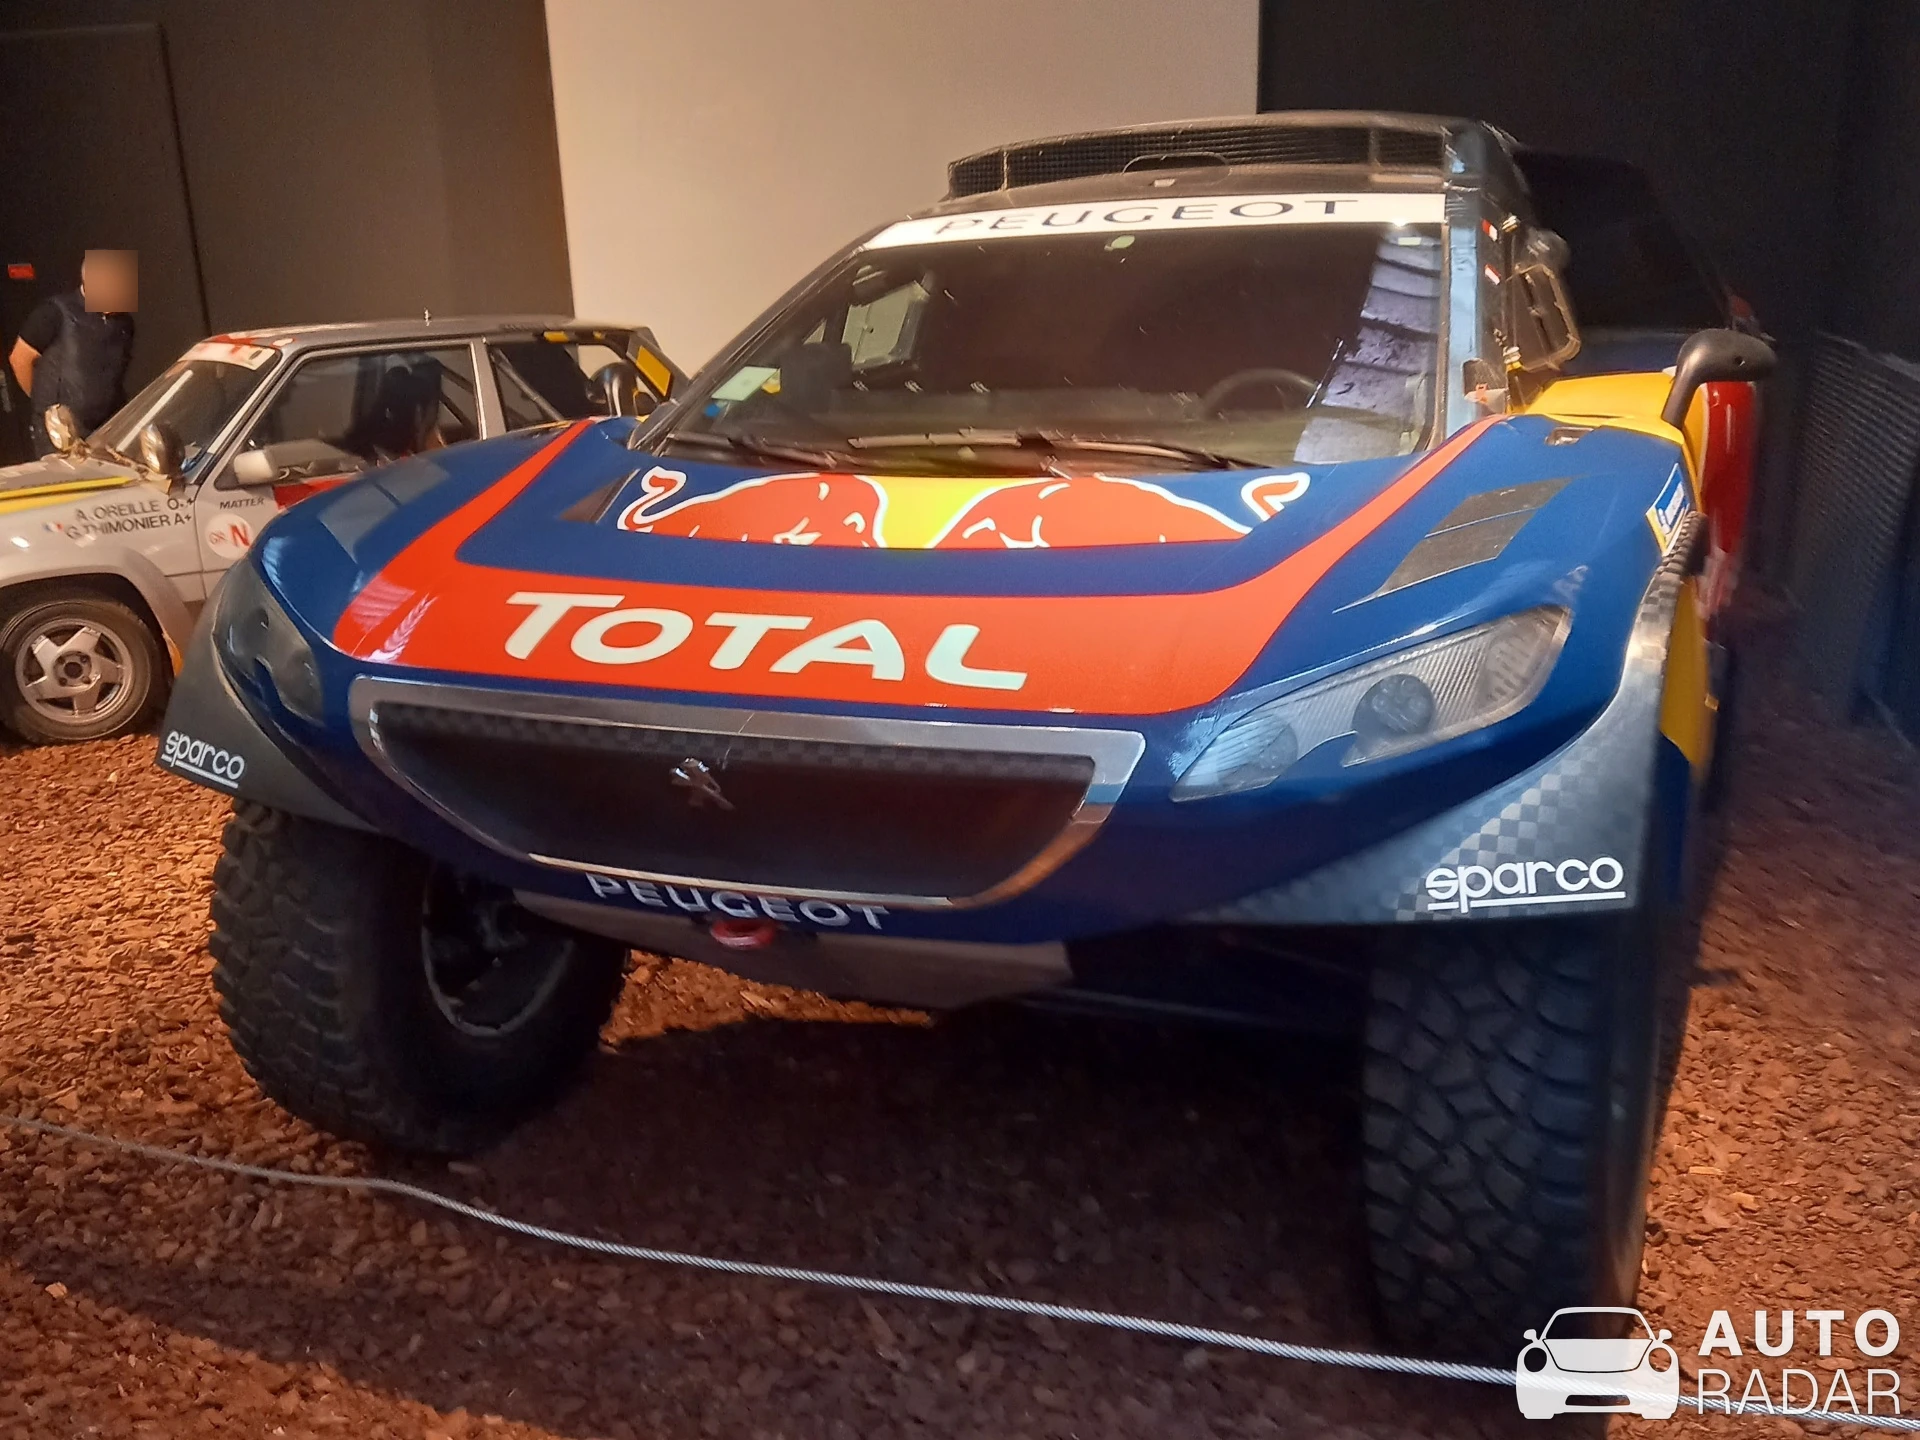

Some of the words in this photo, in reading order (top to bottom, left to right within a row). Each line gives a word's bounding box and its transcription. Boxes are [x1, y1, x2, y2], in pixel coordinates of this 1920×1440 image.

[934, 199, 1358, 235] PEUGEOT
[163, 731, 245, 783] sparco
[585, 872, 890, 930] PEUGEOT
[1425, 856, 1625, 913] sparco
